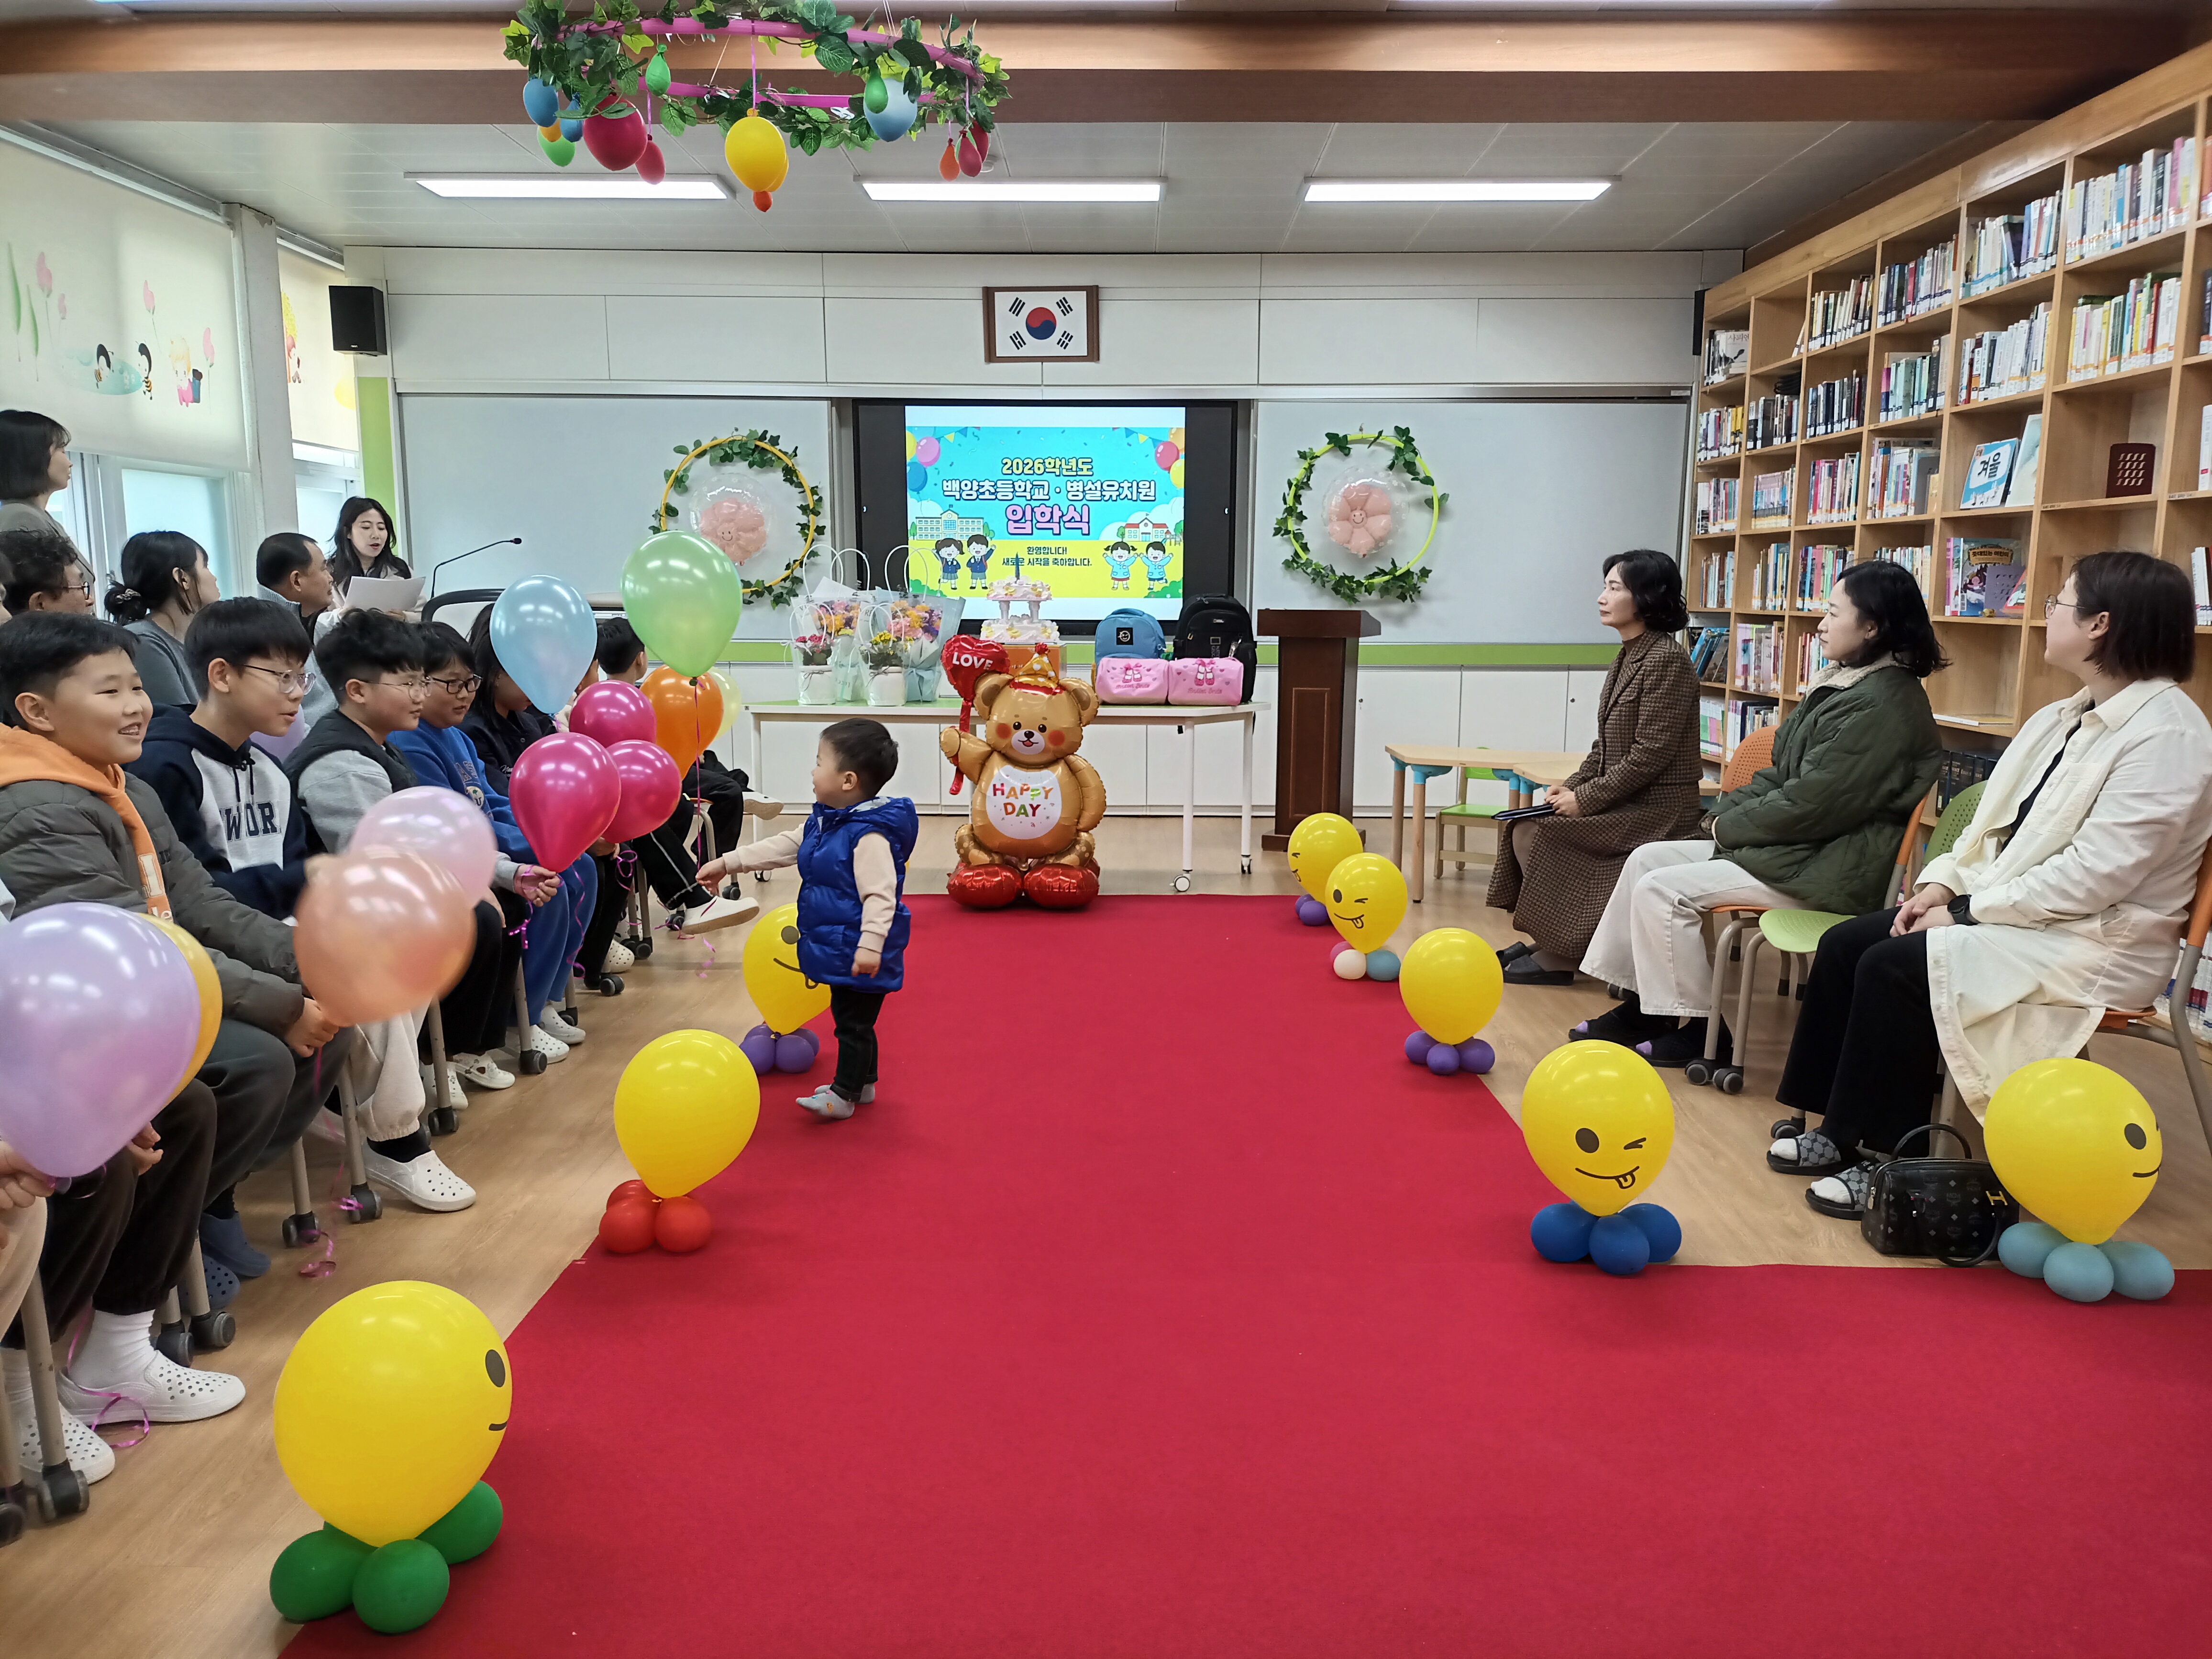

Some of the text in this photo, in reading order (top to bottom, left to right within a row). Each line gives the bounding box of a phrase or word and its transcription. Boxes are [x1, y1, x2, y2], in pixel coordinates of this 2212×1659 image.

[1002, 457, 1094, 476] 2026학년도
[1977, 452, 2001, 478] 겨울
[942, 479, 1050, 501] 백양초등학교
[1066, 480, 1156, 501] 병설유치원
[1006, 504, 1091, 535] 입학식
[1027, 546, 1067, 555] 환영합니다!
[1002, 558, 1025, 566] 새로운
[1027, 558, 1050, 566] 시작을
[952, 652, 993, 670] LOVE
[993, 783, 1053, 800] HAPPY
[1003, 802, 1041, 817] DAY
[219, 800, 282, 842] WOR
